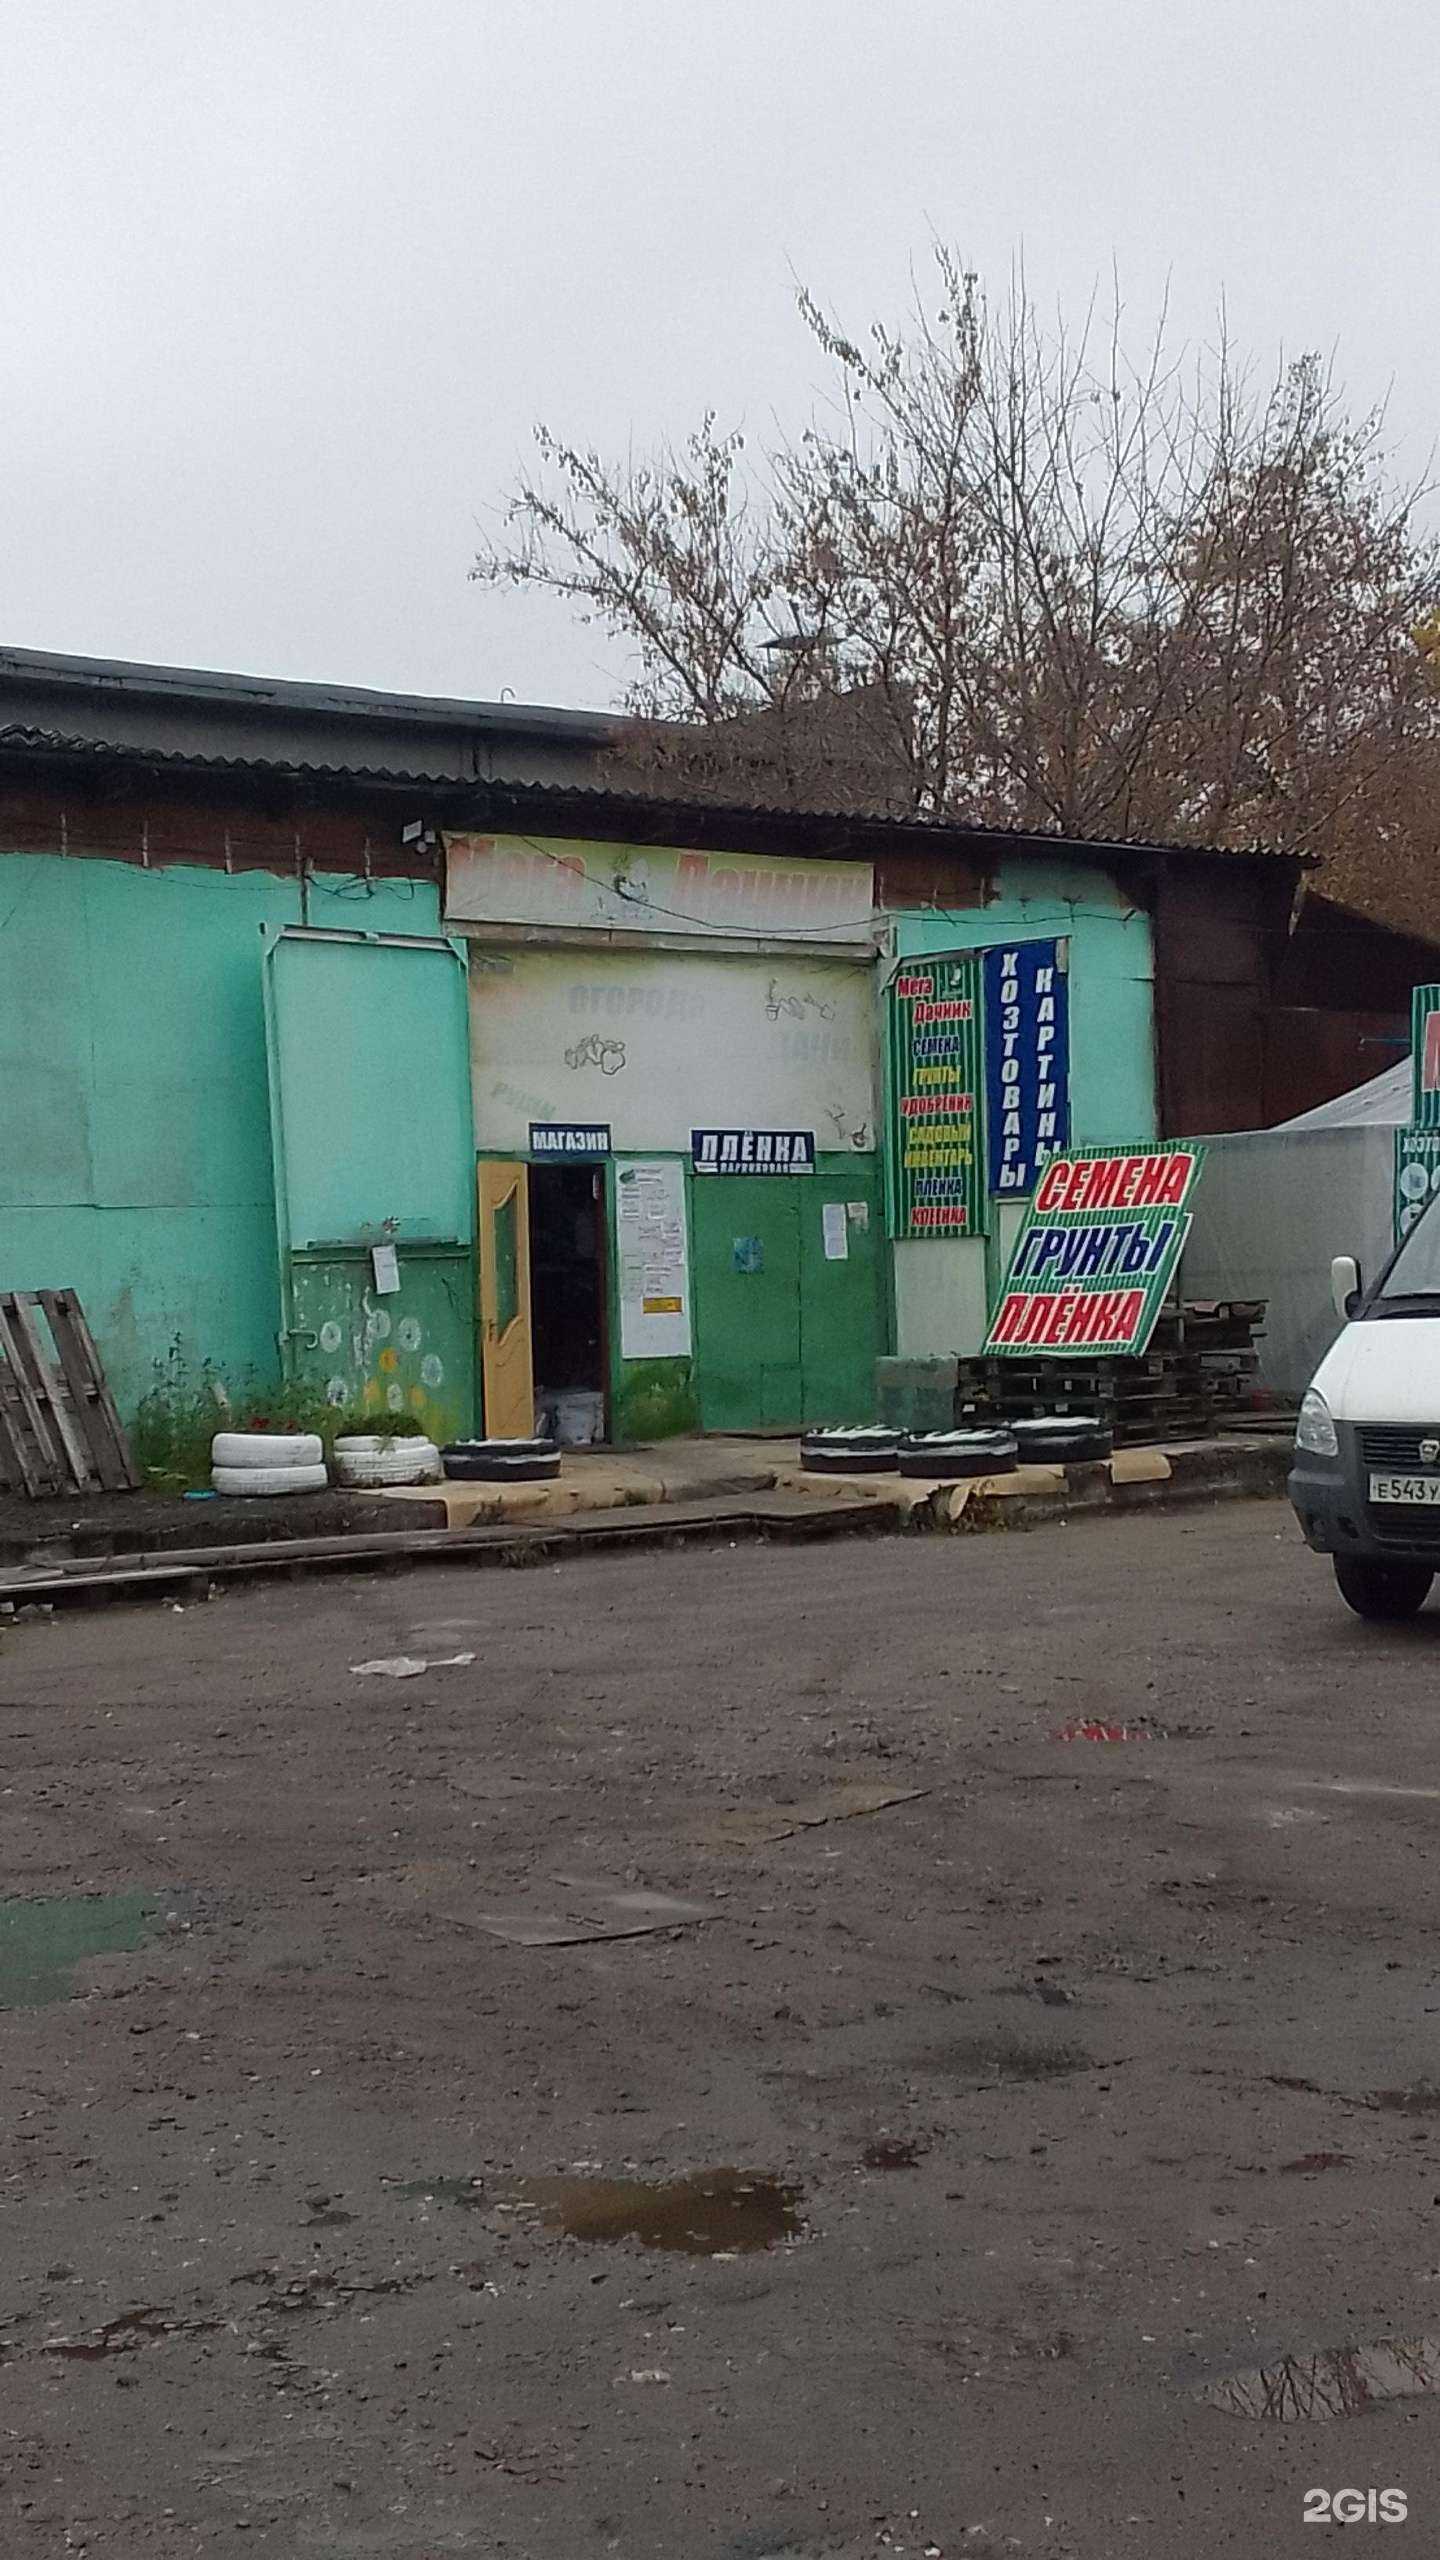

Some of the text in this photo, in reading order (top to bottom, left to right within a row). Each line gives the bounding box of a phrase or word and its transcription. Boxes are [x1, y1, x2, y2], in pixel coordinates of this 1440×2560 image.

[913, 1000, 973, 1026] Дачник
[913, 1036, 960, 1056] СЕМЕНА
[913, 1066, 961, 1085] ГРУНТЫ
[1000, 952, 1026, 1188] ХОЗТОВАРЫ
[532, 1131, 608, 1151] МАГАЗИН
[1036, 1153, 1195, 1214] СЕМЕНА
[1010, 1220, 1177, 1280] ГРУНТЫ
[987, 1284, 1147, 1345] ПЛЁНКА
